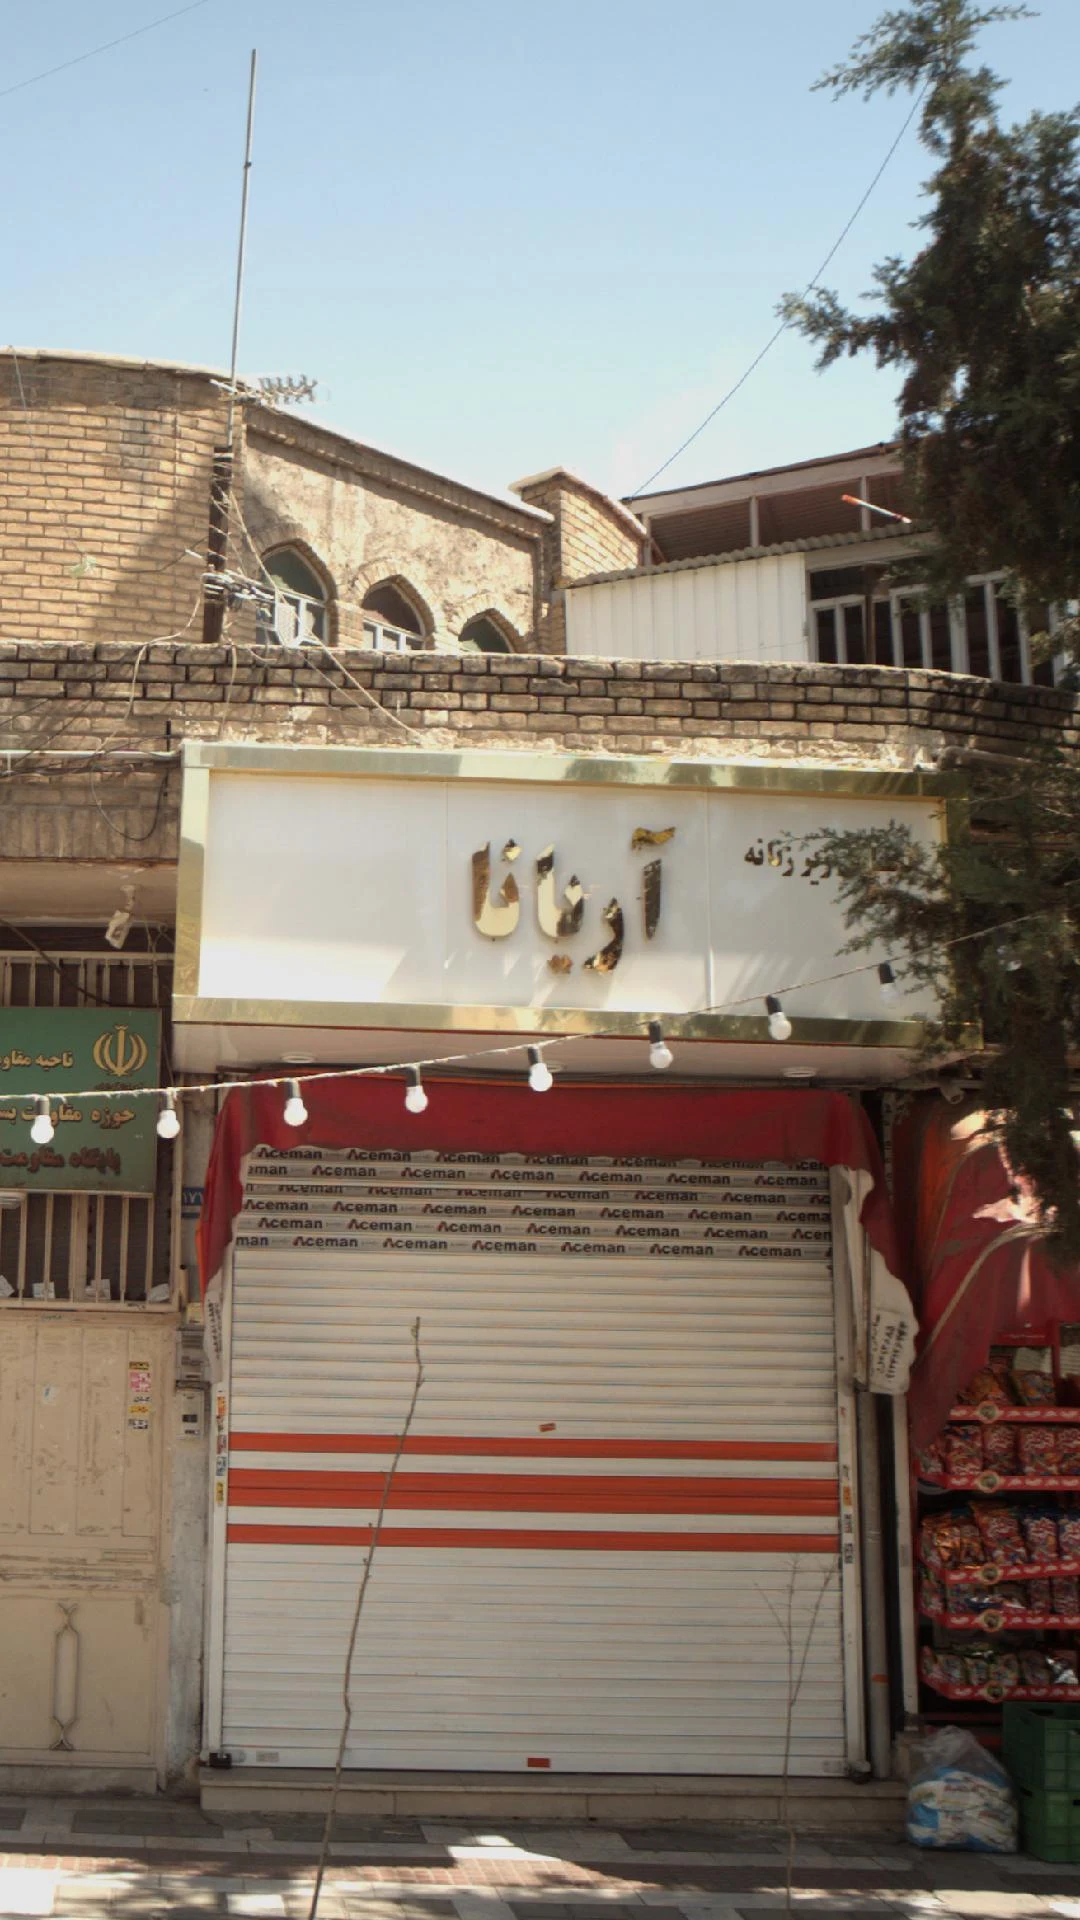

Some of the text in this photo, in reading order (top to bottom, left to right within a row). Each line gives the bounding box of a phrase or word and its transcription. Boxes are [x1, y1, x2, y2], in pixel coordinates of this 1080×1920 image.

[471, 826, 676, 975] آریانا
[35, 1051, 74, 1072] ناحیه
[21, 1104, 82, 1129] مقاوت
[91, 1107, 135, 1130] حوزه
[258, 1147, 322, 1159] Aceman
[347, 1149, 411, 1162] Aceman
[312, 1165, 376, 1177] Aceman
[401, 1167, 466, 1179] Aceman
[490, 1169, 555, 1181] Aceman
[579, 1171, 643, 1182] Aceman
[667, 1173, 731, 1184] Aceman
[754, 1175, 818, 1186] Aceman
[634, 1190, 698, 1201] Aceman
[721, 1192, 786, 1203] Aceman
[244, 1199, 309, 1210] Aceman
[333, 1201, 398, 1213] Aceman
[422, 1203, 487, 1215] Aceman
[511, 1205, 576, 1217] Aceman
[600, 1207, 665, 1219] Aceman
[688, 1209, 752, 1220] Aceman
[258, 1217, 323, 1229] Aceman
[348, 1219, 412, 1231] Aceman
[437, 1221, 502, 1233] Aceman
[526, 1223, 591, 1235] Aceman
[616, 1225, 680, 1237] Aceman
[704, 1227, 768, 1239] Aceman
[293, 1236, 358, 1248] Aceman
[383, 1238, 448, 1249] Aceman
[472, 1240, 537, 1252] Aceman
[561, 1242, 626, 1253] Aceman
[650, 1243, 714, 1255] Aceman
[738, 1245, 802, 1257] Aceman
